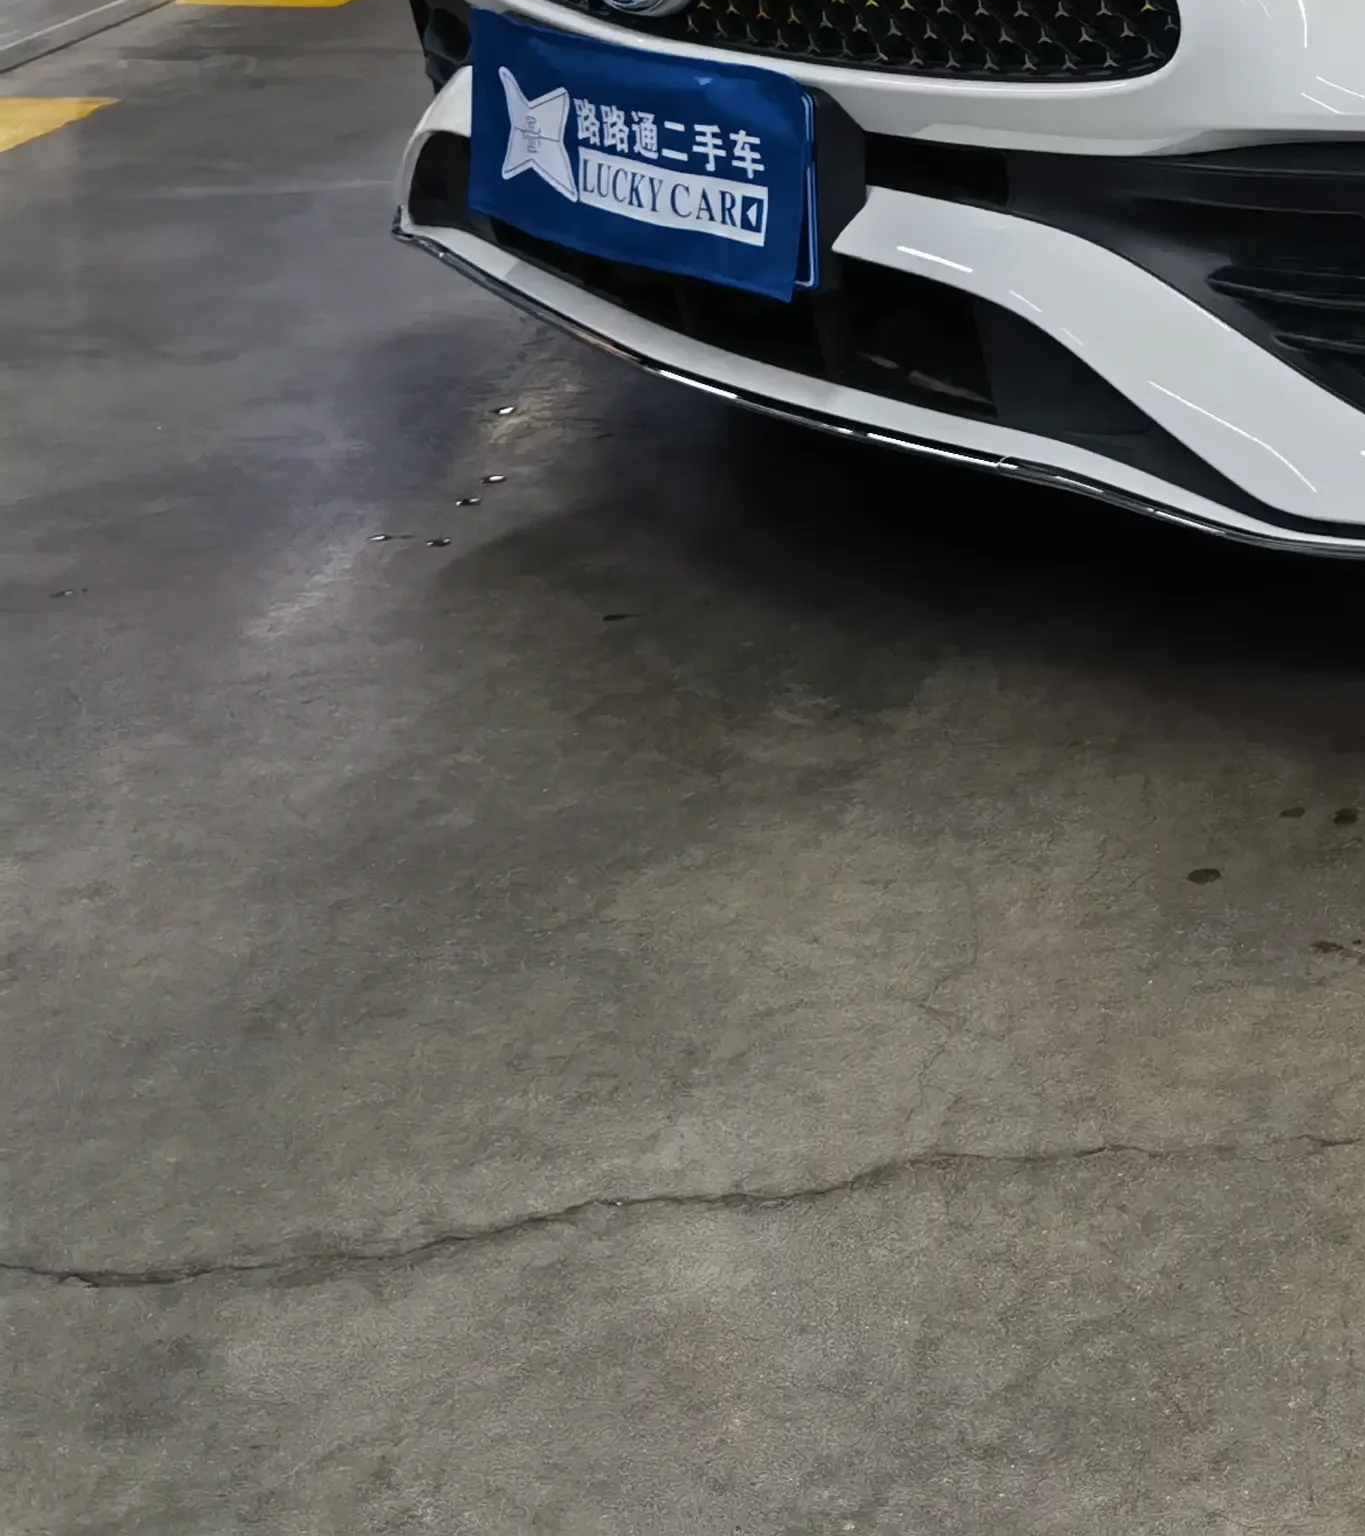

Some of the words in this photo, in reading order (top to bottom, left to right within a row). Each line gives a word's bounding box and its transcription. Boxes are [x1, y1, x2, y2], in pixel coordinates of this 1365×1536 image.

[573, 98, 765, 179] 路路通二手车
[582, 159, 664, 213] LUCKY
[670, 183, 737, 228] CAR
